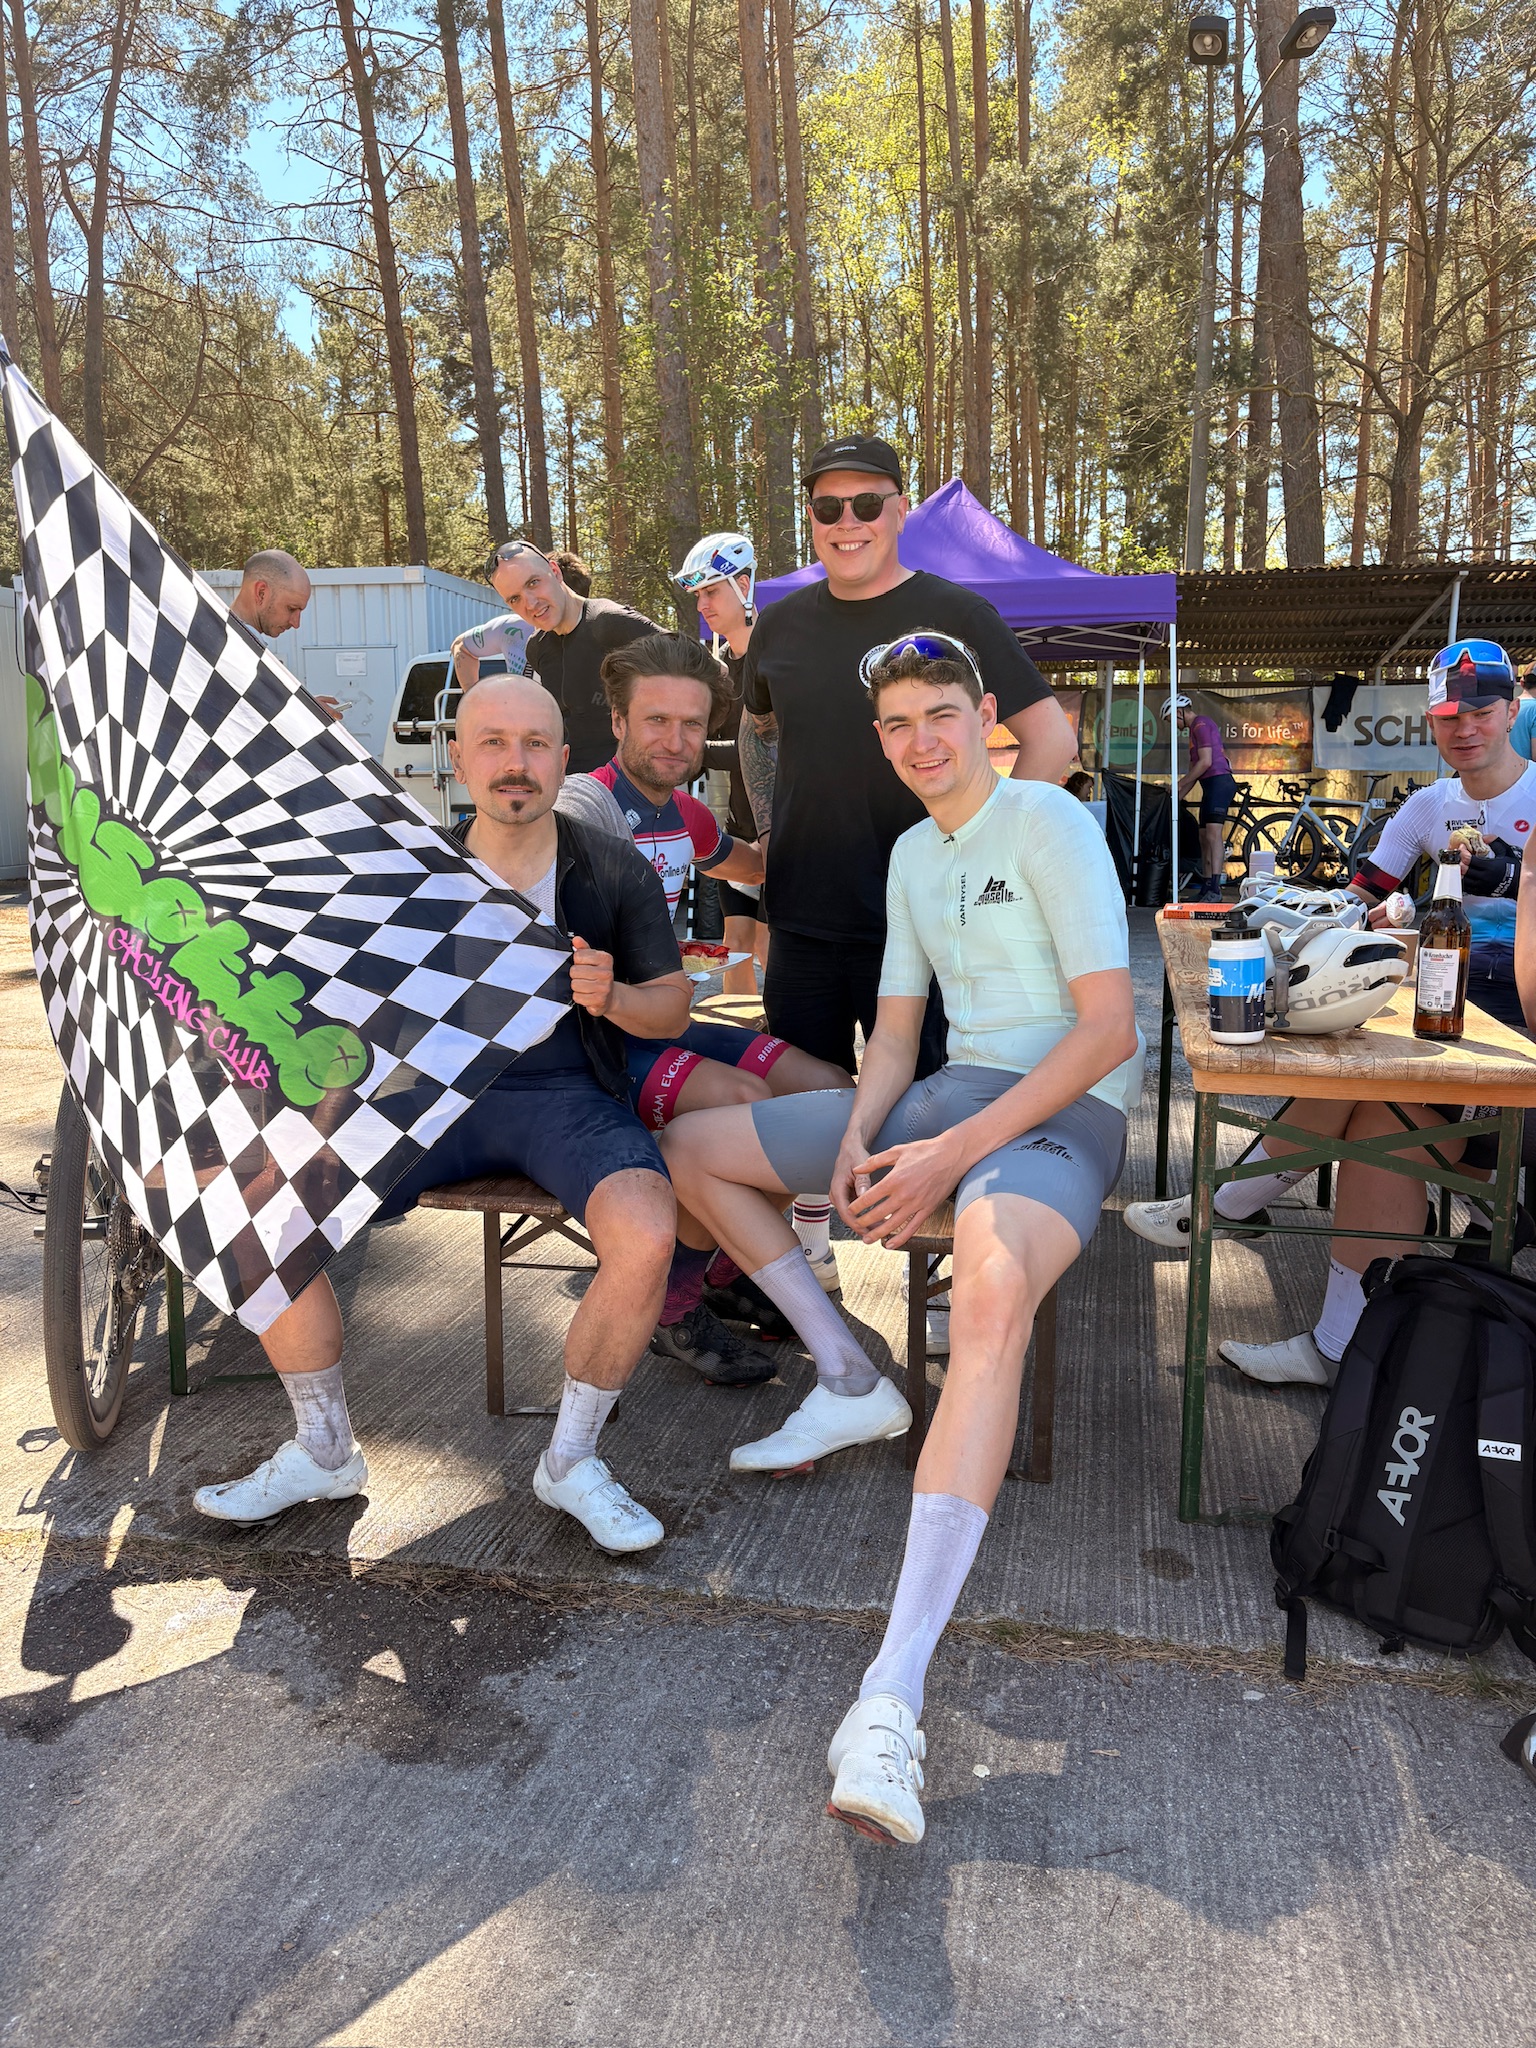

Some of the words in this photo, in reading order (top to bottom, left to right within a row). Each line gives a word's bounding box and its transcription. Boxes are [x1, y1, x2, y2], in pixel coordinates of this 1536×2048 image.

[1226, 723, 1238, 739] is
[1242, 722, 1264, 739] for
[107, 927, 211, 1033] CYCLING
[208, 1026, 272, 1090] CLUB
[1377, 1406, 1437, 1527] AEVOR
[1482, 1444, 1516, 1457] AEVOR
